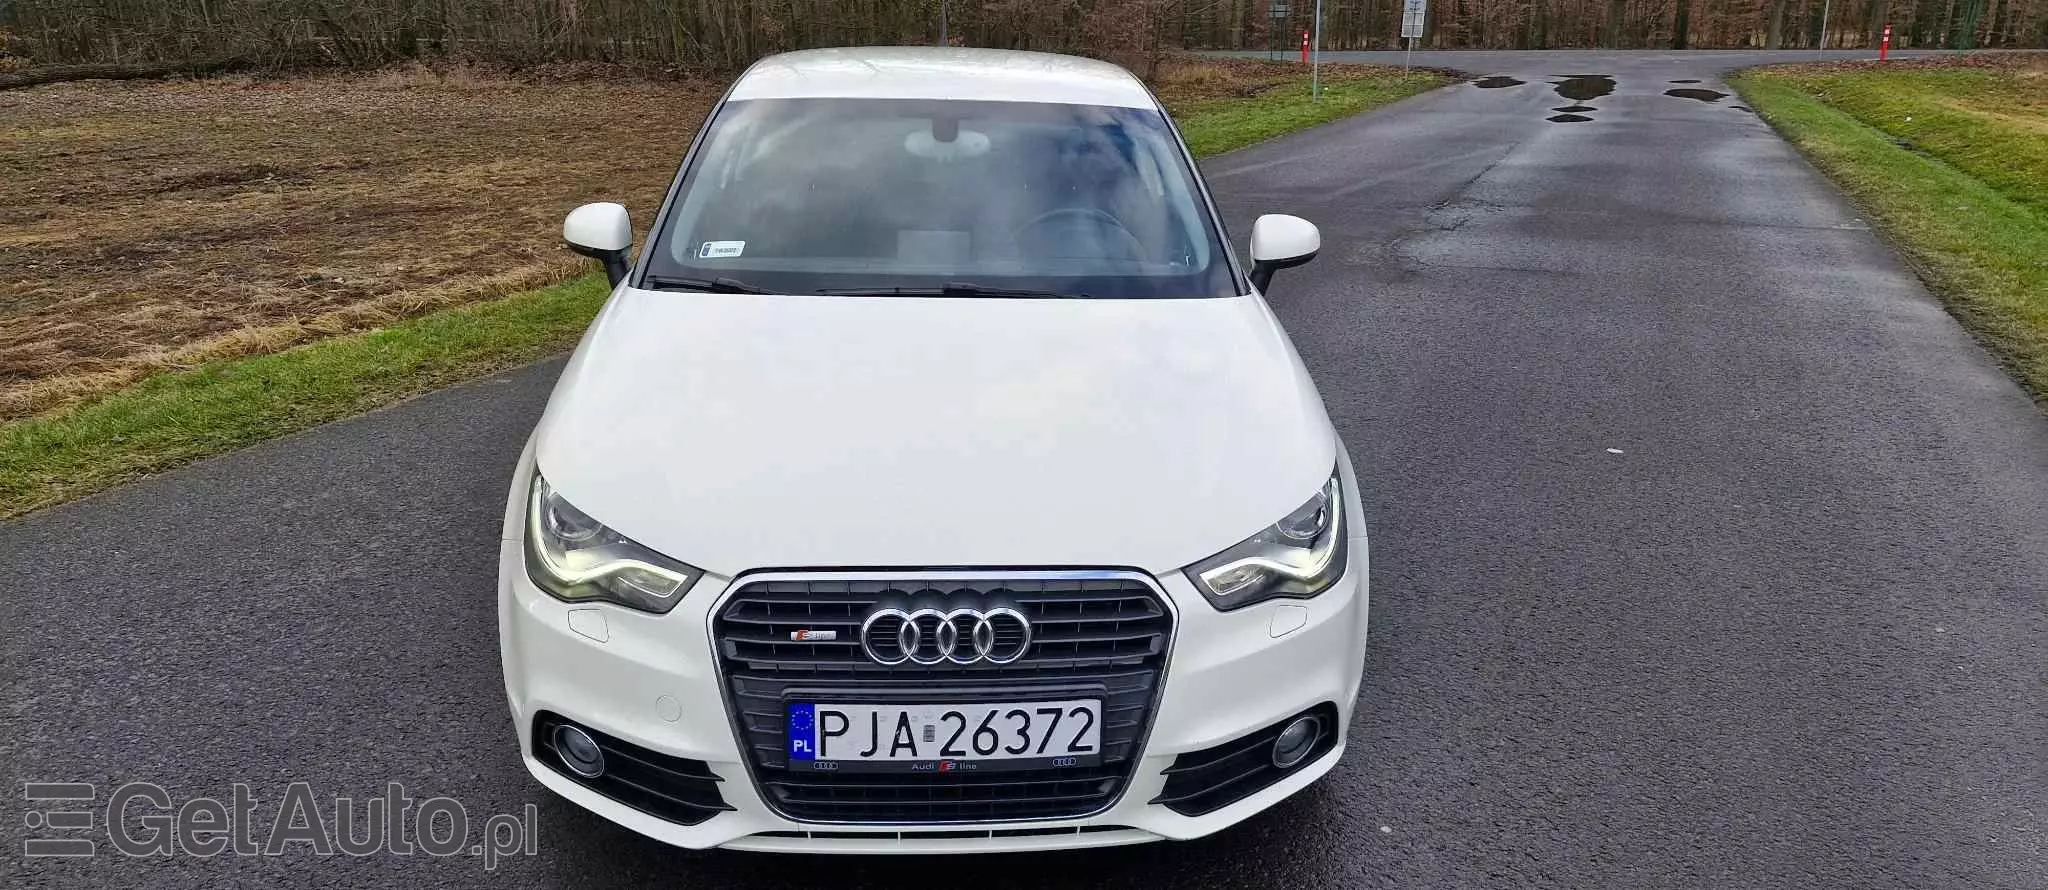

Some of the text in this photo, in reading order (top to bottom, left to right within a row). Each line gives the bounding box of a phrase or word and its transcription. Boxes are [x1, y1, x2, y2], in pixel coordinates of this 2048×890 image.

[820, 706, 1095, 758] PJA 26372
[793, 739, 812, 753] PL
[911, 762, 935, 770] Audi
